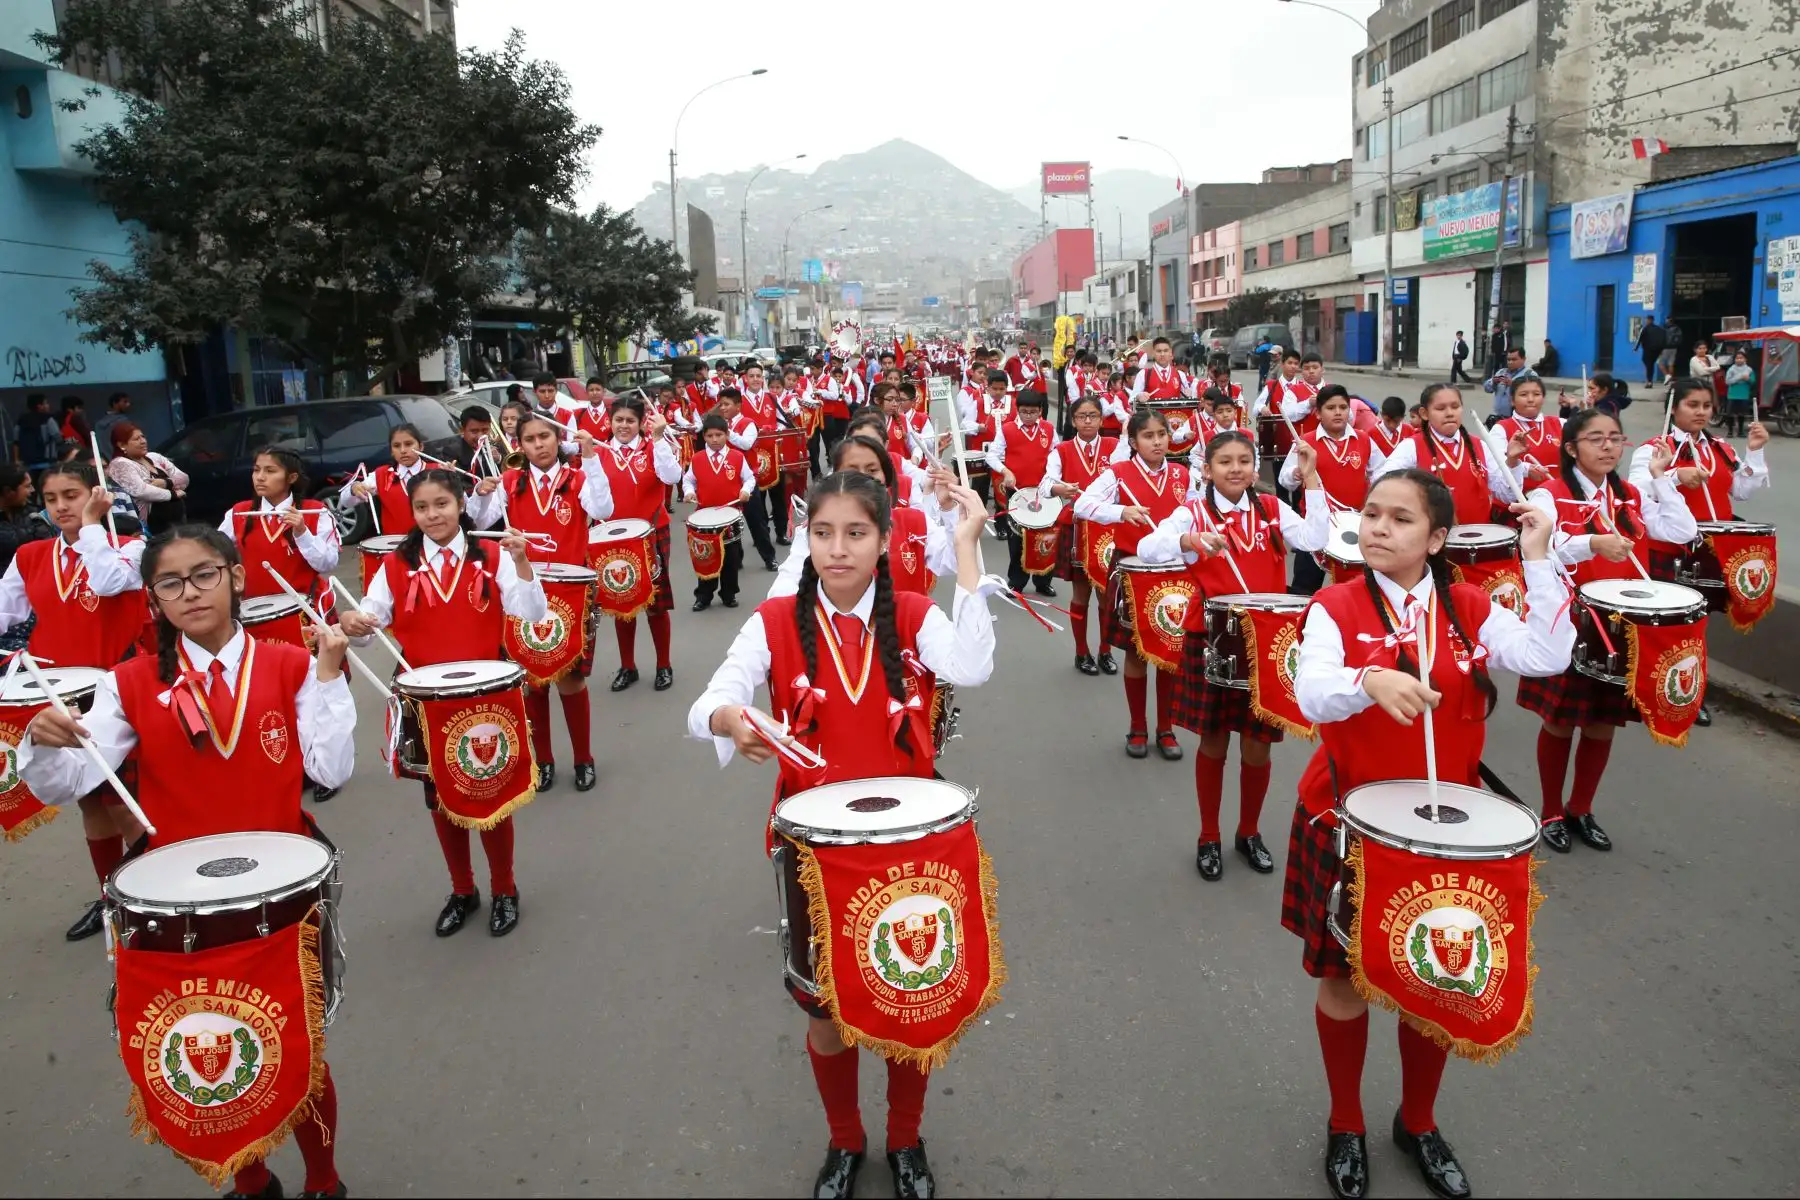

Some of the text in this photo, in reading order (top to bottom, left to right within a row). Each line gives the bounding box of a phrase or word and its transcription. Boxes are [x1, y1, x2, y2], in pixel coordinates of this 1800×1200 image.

[1439, 220, 1466, 238] NUEVO
[1468, 211, 1500, 232] MEXICO
[834, 318, 853, 335] SAN
[1143, 584, 1160, 615] BANDA
[1161, 580, 1174, 589] DE
[1268, 622, 1295, 661] BANDA
[1650, 644, 1680, 679] BANDA
[441, 703, 520, 735] BANDA DE MUSICA
[447, 719, 474, 761] COLEGIO
[842, 861, 968, 940] BANDA DE MUSICA
[1379, 880, 1427, 935] BANDA
[1430, 872, 1460, 889] DE
[857, 892, 893, 963] COLEGIO
[897, 923, 904, 931] C
[898, 926, 935, 940] SAN JOSE
[1392, 898, 1433, 958] COLEGIO
[1452, 942, 1471, 950] JOSE
[865, 943, 963, 1003] ESTUDIO, TRABAJO, TRIUNFO
[1398, 962, 1430, 993] ESTUDIO,
[1479, 969, 1502, 1004] TRIUNFO
[129, 977, 288, 1049] BANDA DE MUSICA
[872, 999, 899, 1017] PARQUE
[902, 1010, 910, 1018] 12
[912, 1009, 921, 1017] DE
[913, 1007, 951, 1024] VICTORIA
[147, 1003, 188, 1073] COLEGIO
[188, 1038, 196, 1046] C
[207, 1046, 229, 1055] JOSE
[152, 1064, 275, 1118] ESTUDIO, TRABAJO, TRIUNFO
[161, 1108, 188, 1129] PARQUE
